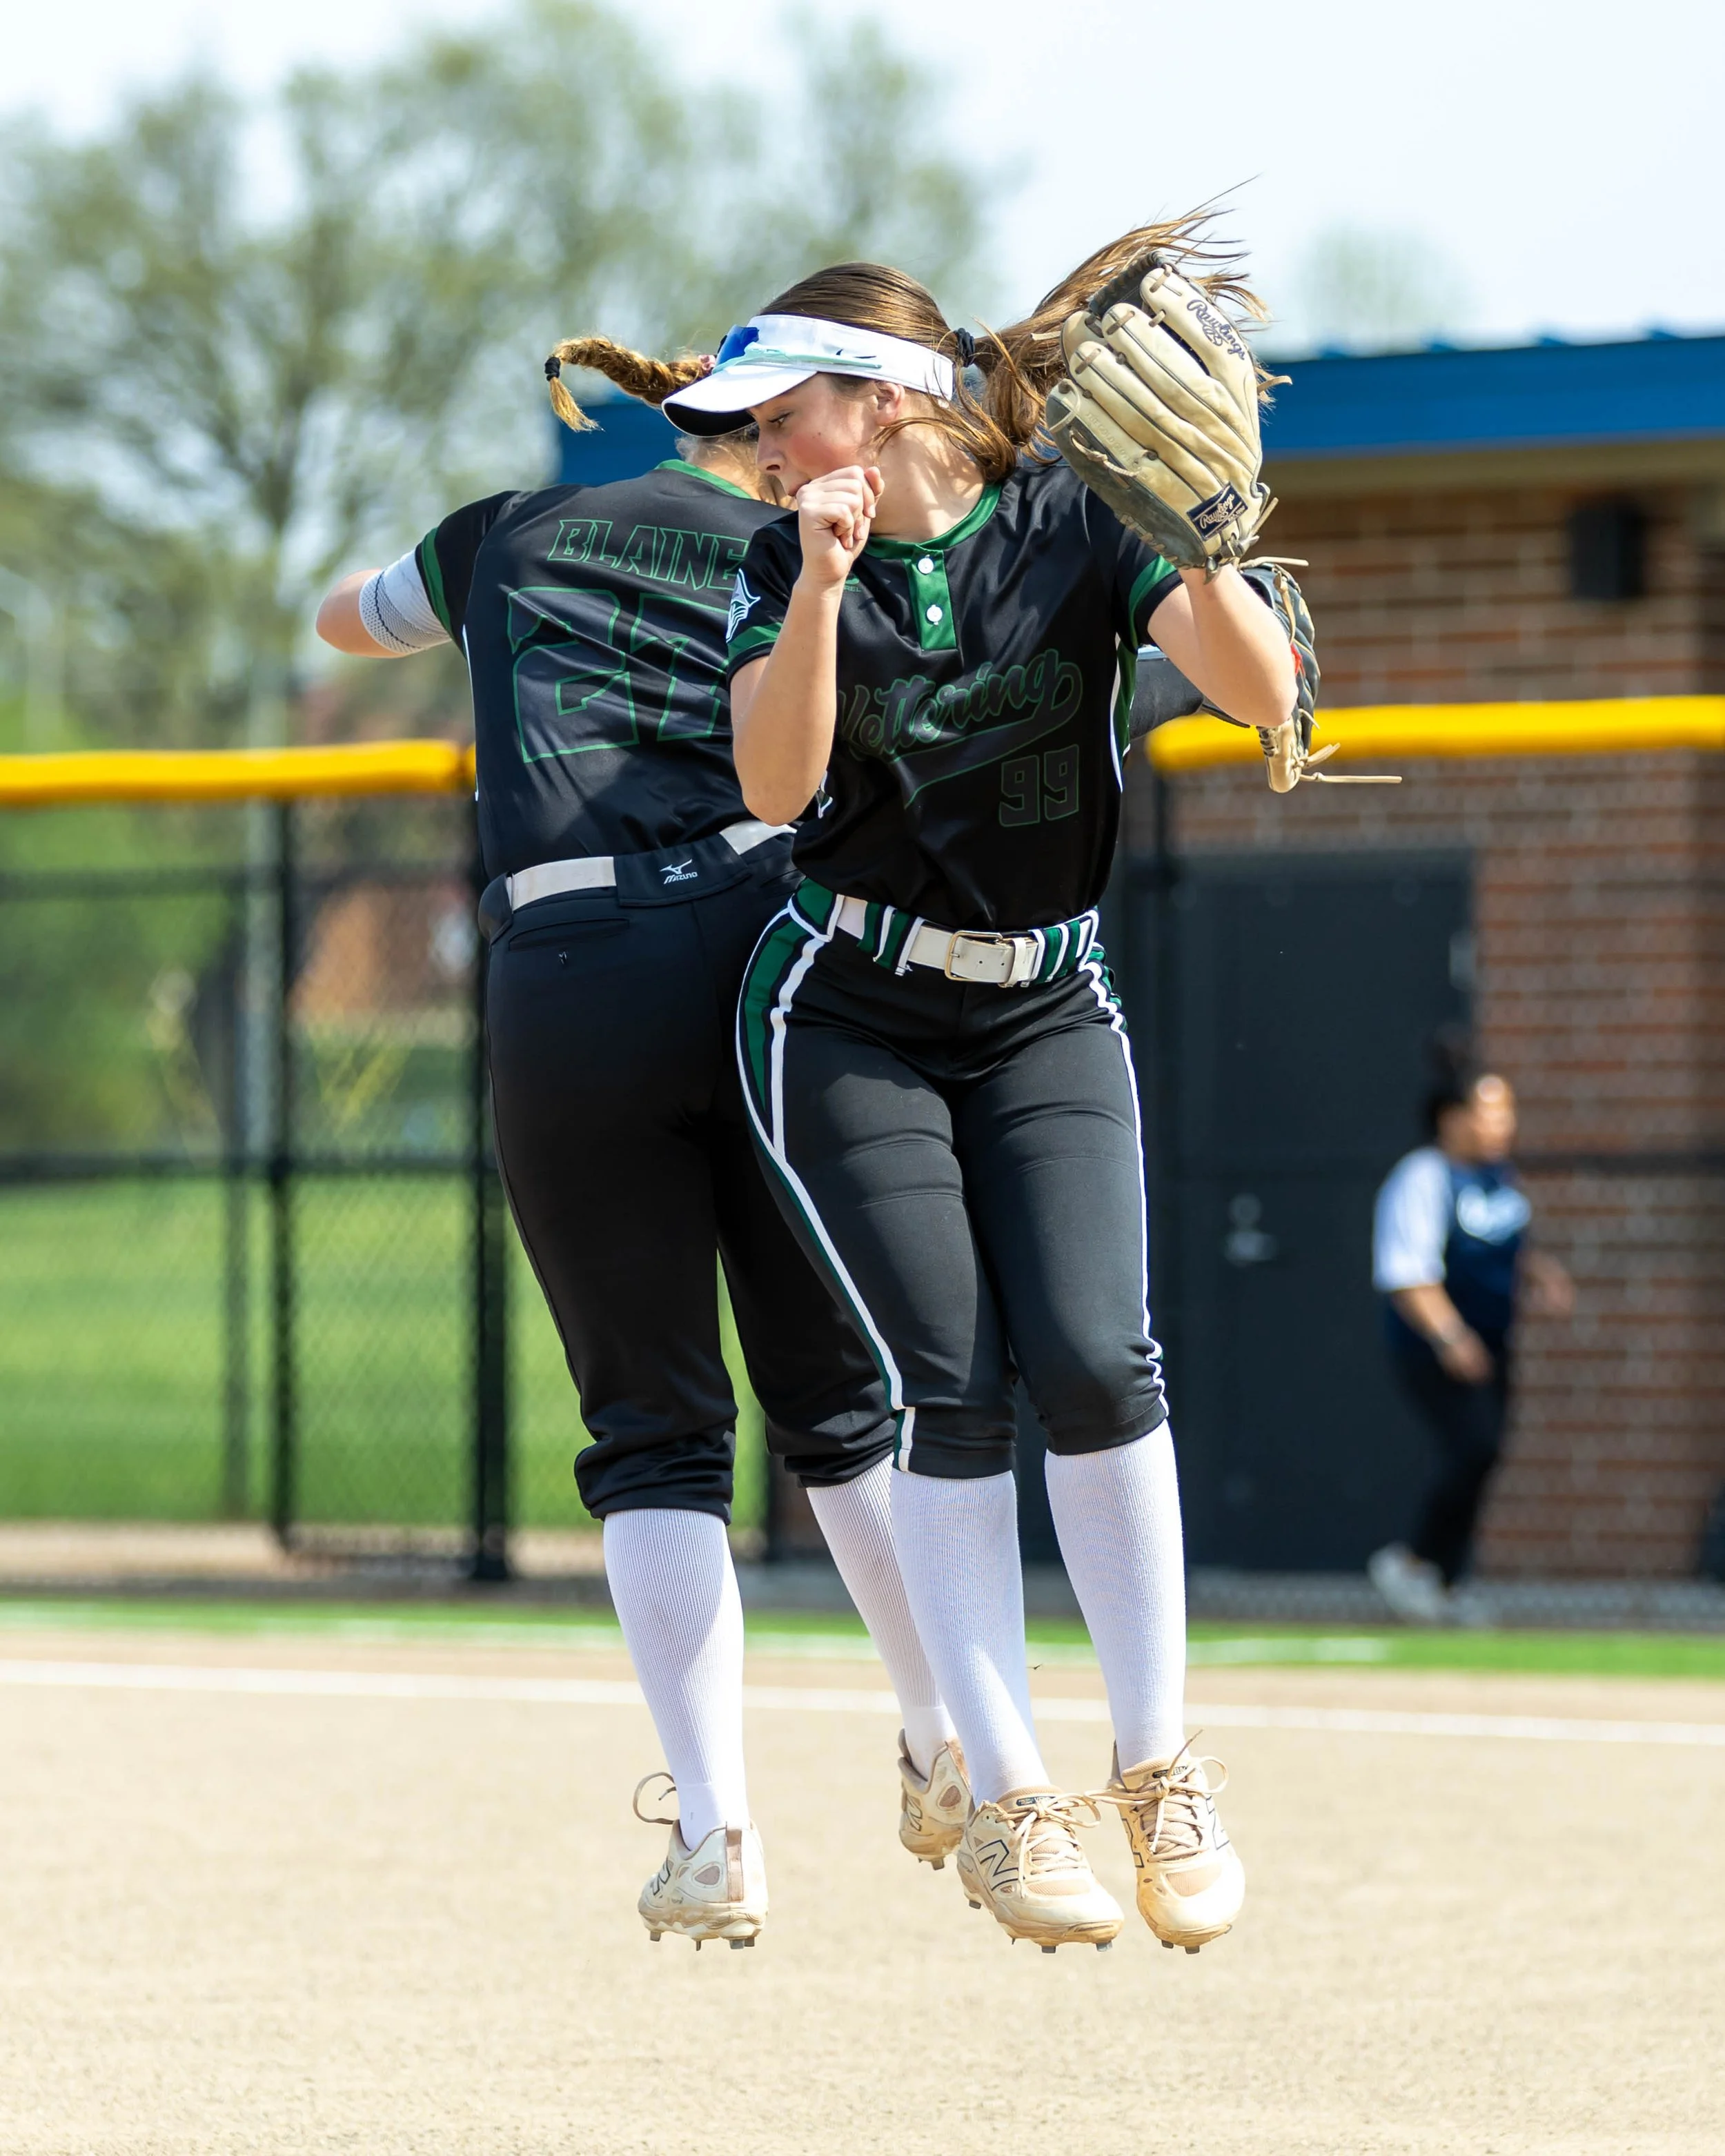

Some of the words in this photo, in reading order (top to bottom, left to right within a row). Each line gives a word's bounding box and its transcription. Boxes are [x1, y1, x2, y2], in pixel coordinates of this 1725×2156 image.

[1187, 299, 1245, 360] Rawlings
[1200, 493, 1235, 529] Rawlings
[547, 519, 749, 591] BLAINE
[507, 586, 729, 763] 27
[998, 744, 1080, 827] 99
